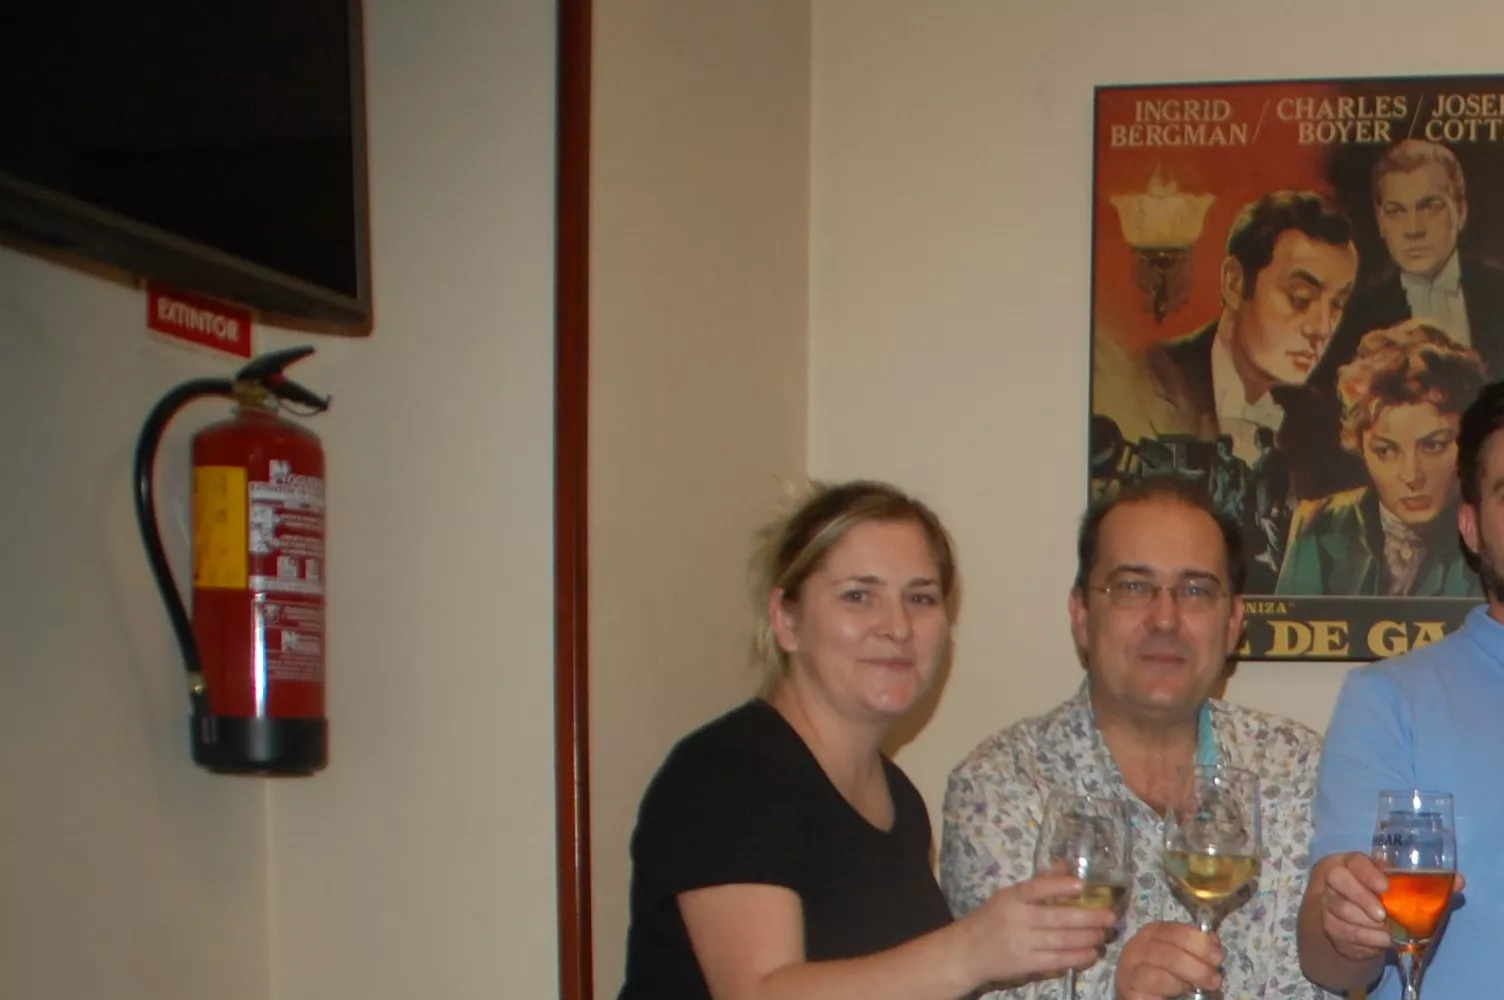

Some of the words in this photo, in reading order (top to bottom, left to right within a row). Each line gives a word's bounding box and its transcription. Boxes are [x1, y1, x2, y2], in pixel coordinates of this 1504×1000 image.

[1135, 100, 1231, 122] INGRID
[1276, 96, 1408, 121] CHARLES
[1110, 123, 1248, 147] BERGMAN
[1298, 120, 1392, 144] BOYER
[157, 297, 239, 342] EXTINTOR
[1265, 620, 1349, 656] DE
[1367, 620, 1448, 656] GA
